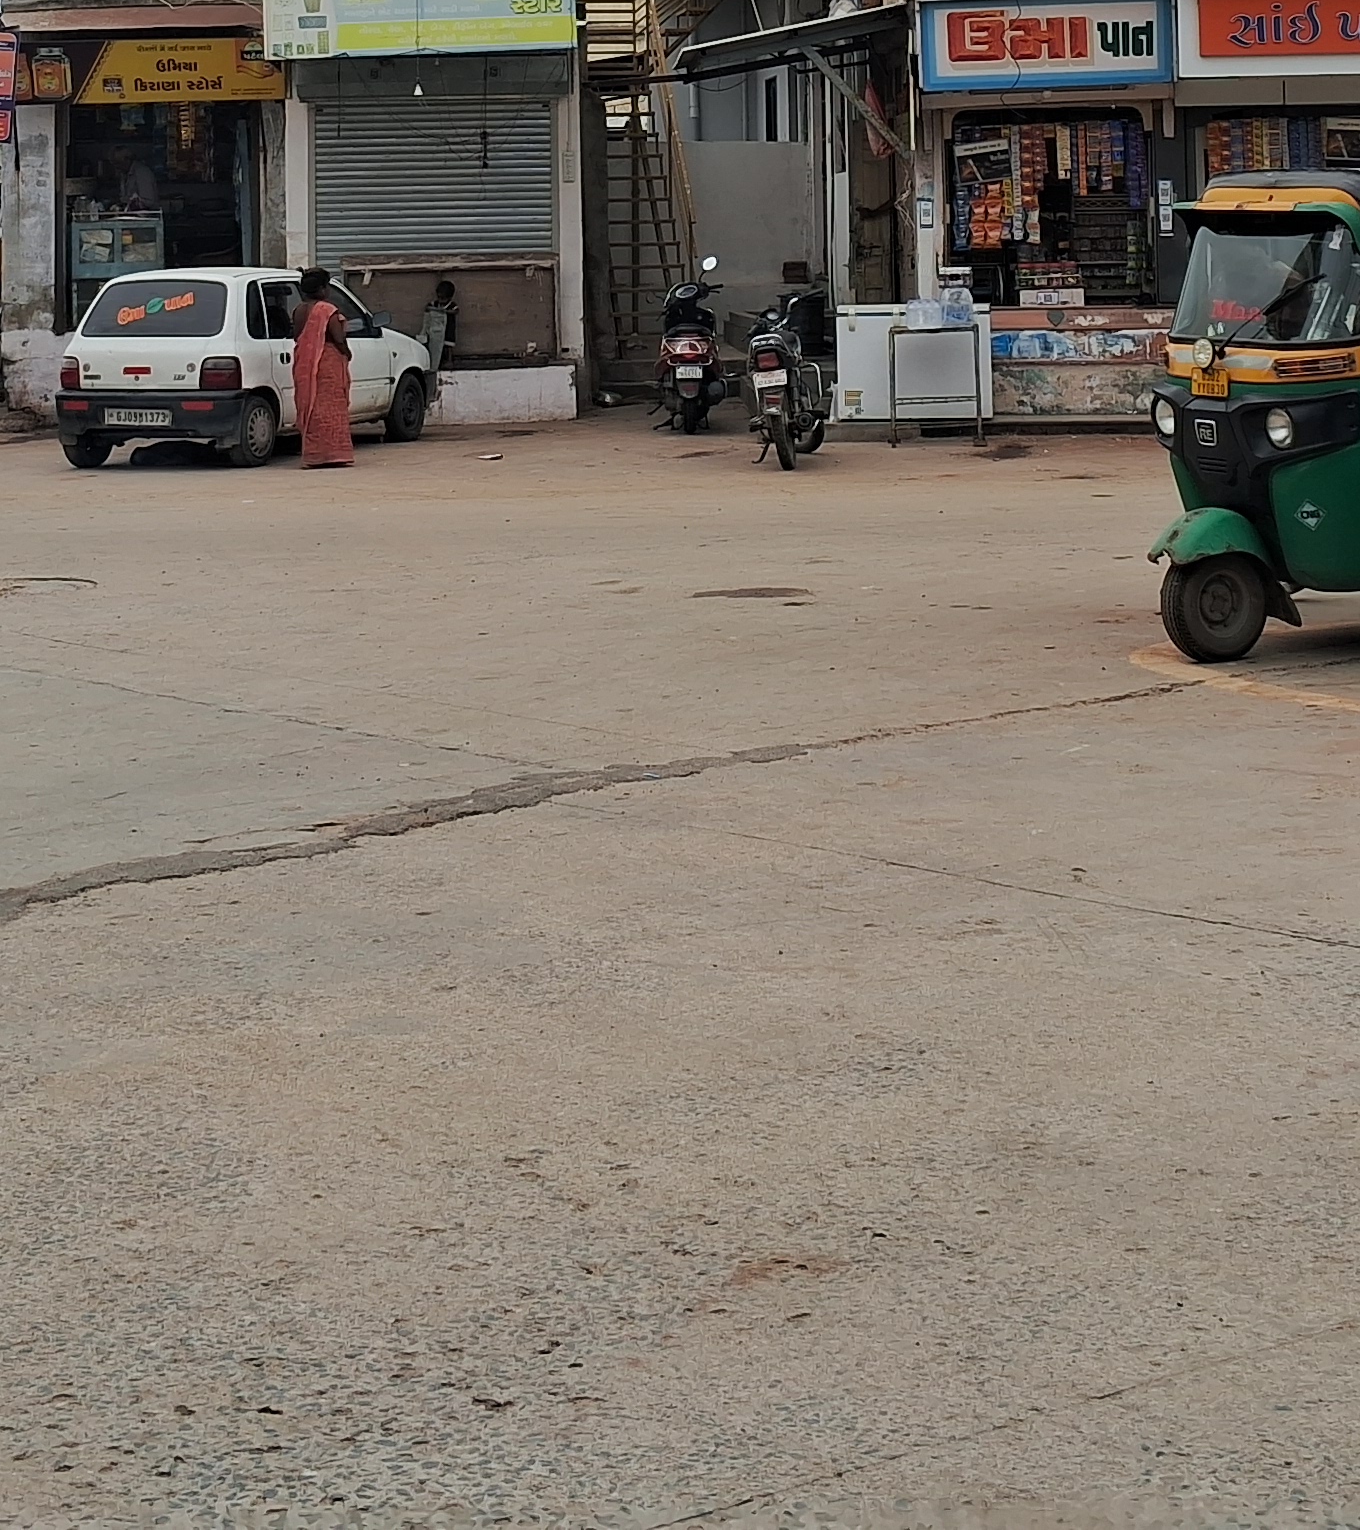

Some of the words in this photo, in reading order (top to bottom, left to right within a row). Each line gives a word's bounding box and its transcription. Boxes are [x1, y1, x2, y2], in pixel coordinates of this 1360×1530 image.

[947, 10, 1088, 62] ઉમા
[1097, 21, 1154, 57] પાન
[156, 59, 198, 72] ઉમિયા
[1211, 300, 1264, 321] Maa
[1199, 428, 1213, 441] RE
